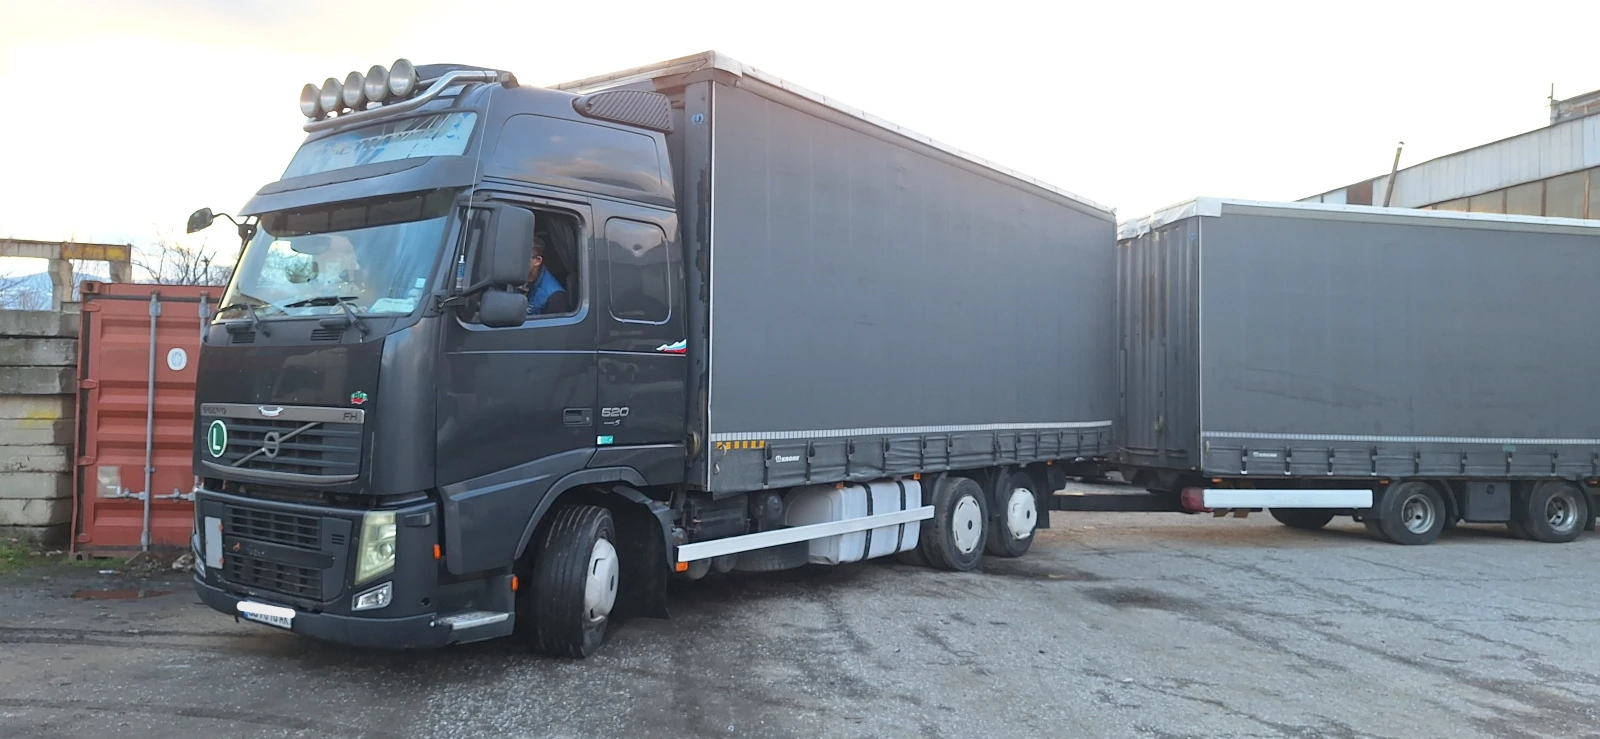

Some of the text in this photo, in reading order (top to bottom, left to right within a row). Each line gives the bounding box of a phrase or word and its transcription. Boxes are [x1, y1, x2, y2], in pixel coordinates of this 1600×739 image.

[343, 412, 358, 421] FH
[601, 406, 630, 417] 520
[212, 428, 221, 450] L
